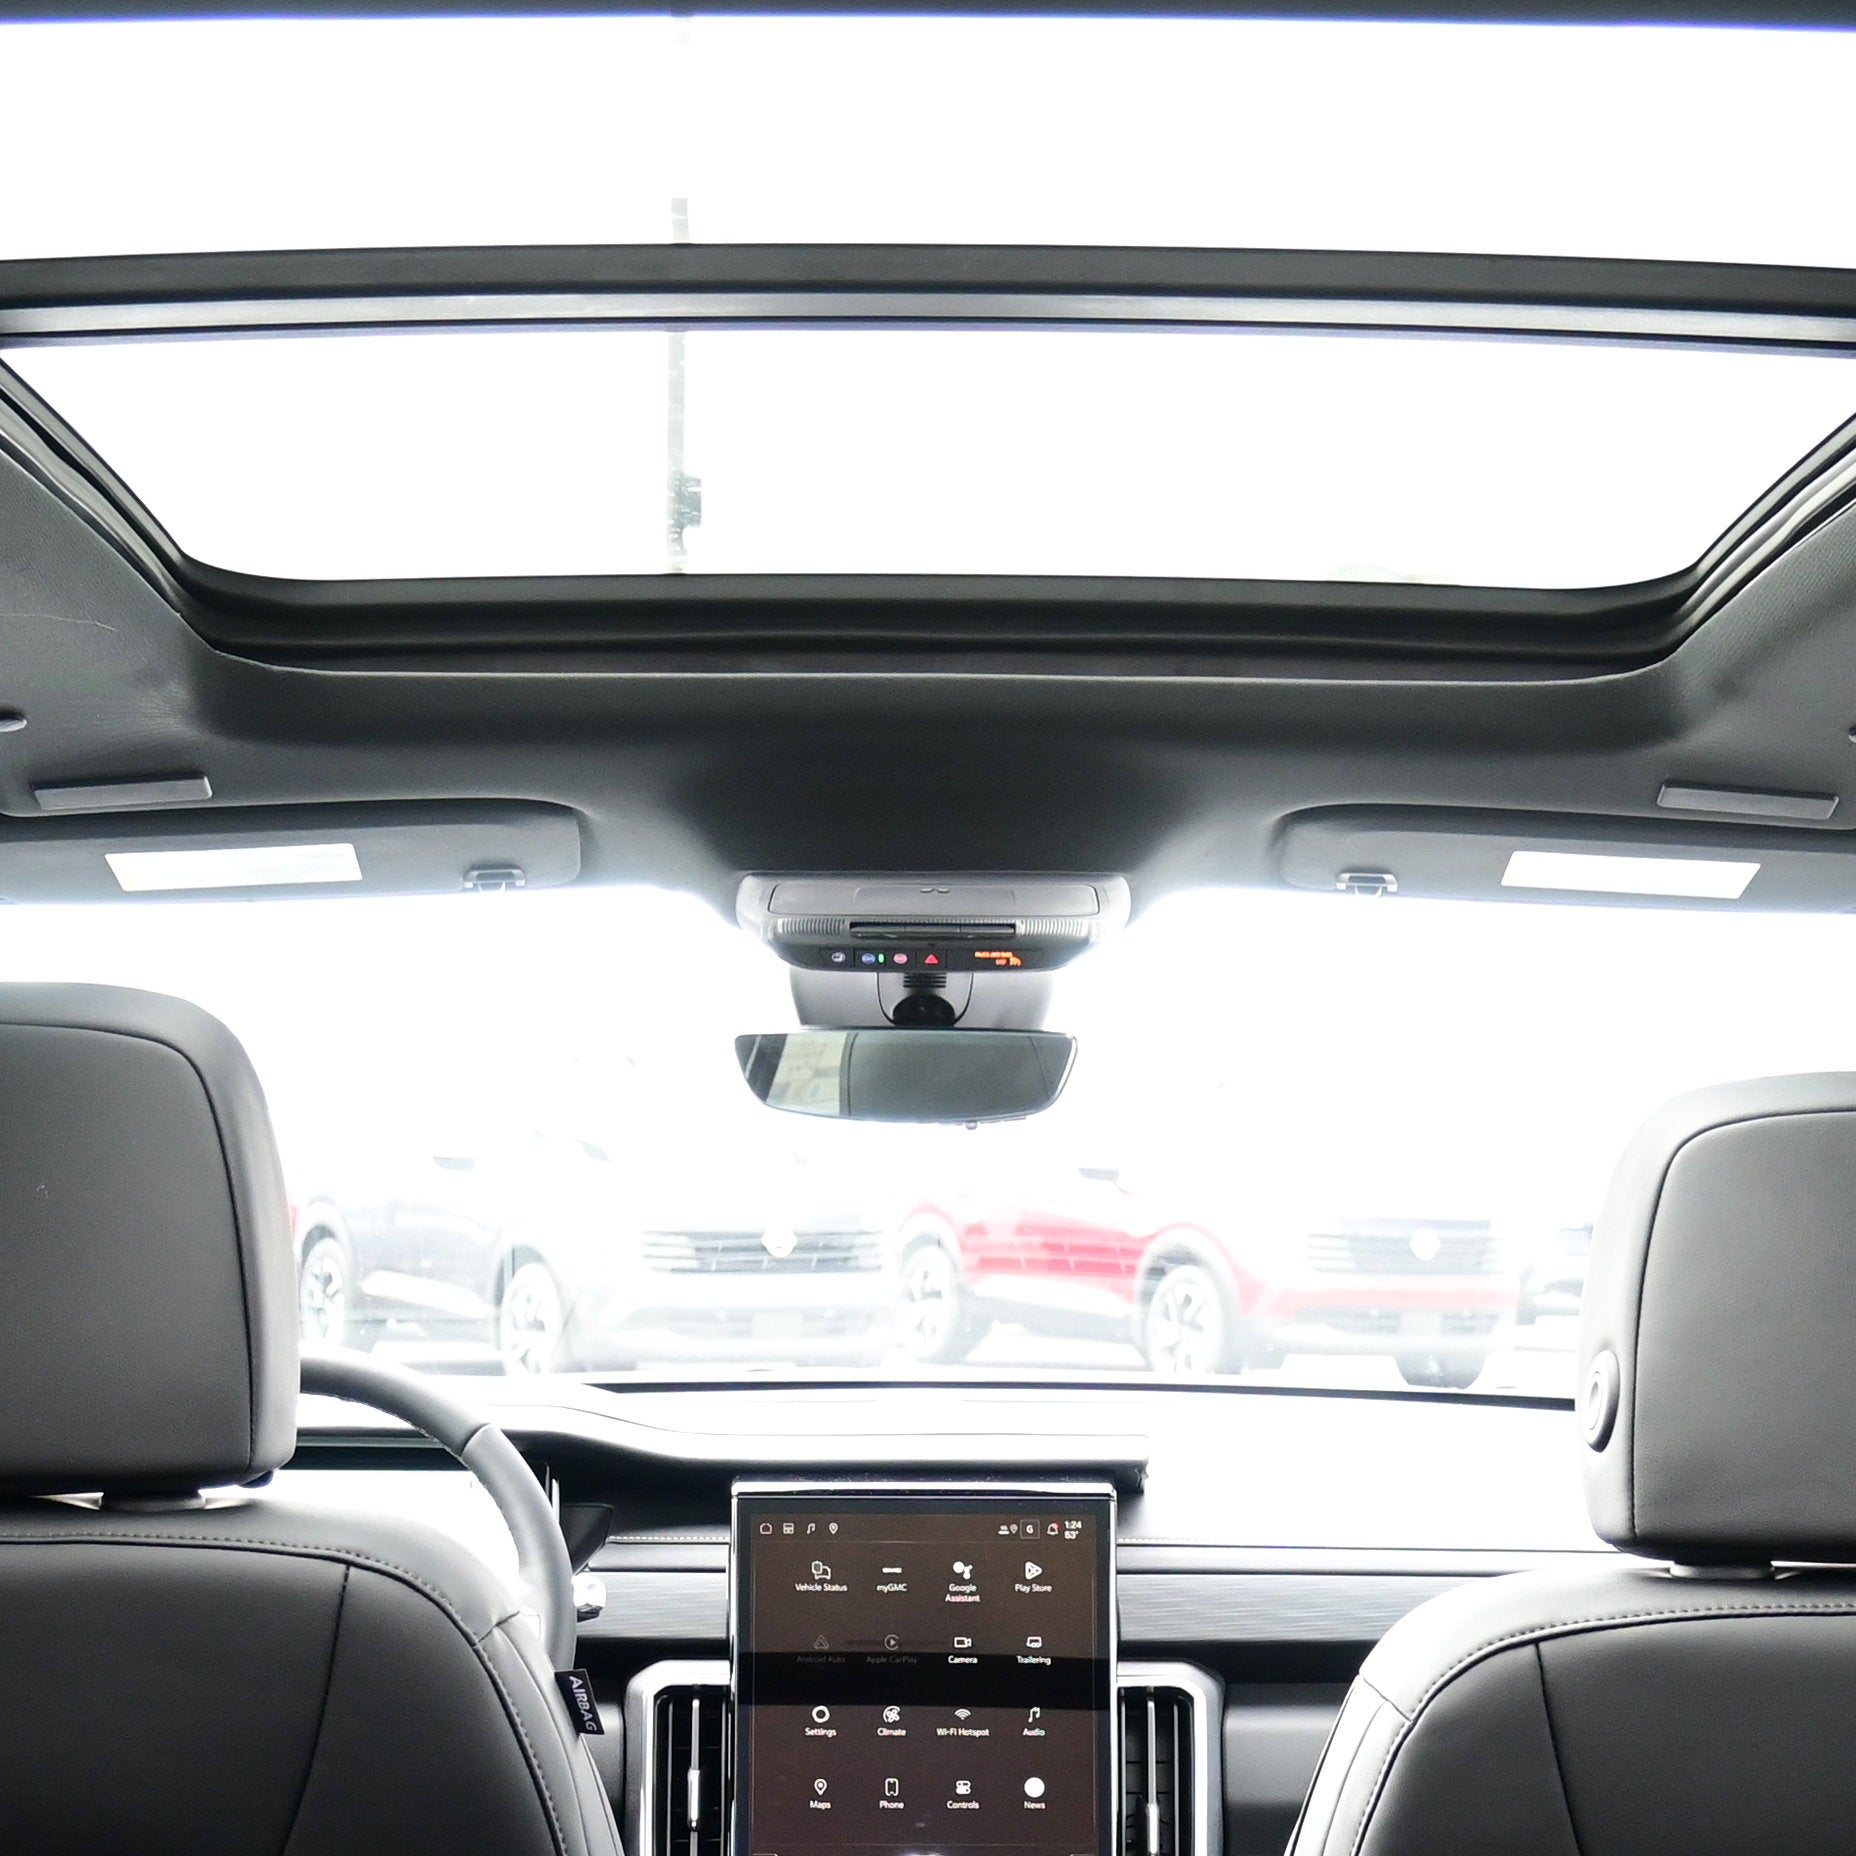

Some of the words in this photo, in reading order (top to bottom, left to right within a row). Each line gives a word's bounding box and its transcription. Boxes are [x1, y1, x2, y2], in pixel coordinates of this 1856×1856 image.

[1064, 1520, 1082, 1529] 1:24
[795, 1582, 822, 1592] Vehicle
[823, 1582, 848, 1592] Status
[876, 1583, 908, 1593] myGMC
[948, 1583, 977, 1594] Google
[1015, 1583, 1031, 1594] Play
[1032, 1583, 1053, 1592] Store
[945, 1594, 981, 1602] Assistant
[796, 1655, 826, 1663] Android
[827, 1655, 846, 1663] Auto
[866, 1655, 888, 1664] Apple
[889, 1655, 919, 1665] CarPlay
[948, 1655, 978, 1664] Camera
[1016, 1655, 1052, 1666] Trailering
[568, 1675, 598, 1732] AIRBAG
[804, 1727, 837, 1738] Settings
[877, 1727, 907, 1737] Climate
[936, 1727, 957, 1737] Wi-Fi
[958, 1727, 990, 1738] Hotspot
[1022, 1727, 1046, 1737] Audio
[809, 1800, 831, 1811] Maps
[879, 1800, 905, 1809] Phone
[946, 1800, 980, 1810] Controls
[1023, 1800, 1046, 1809] News
